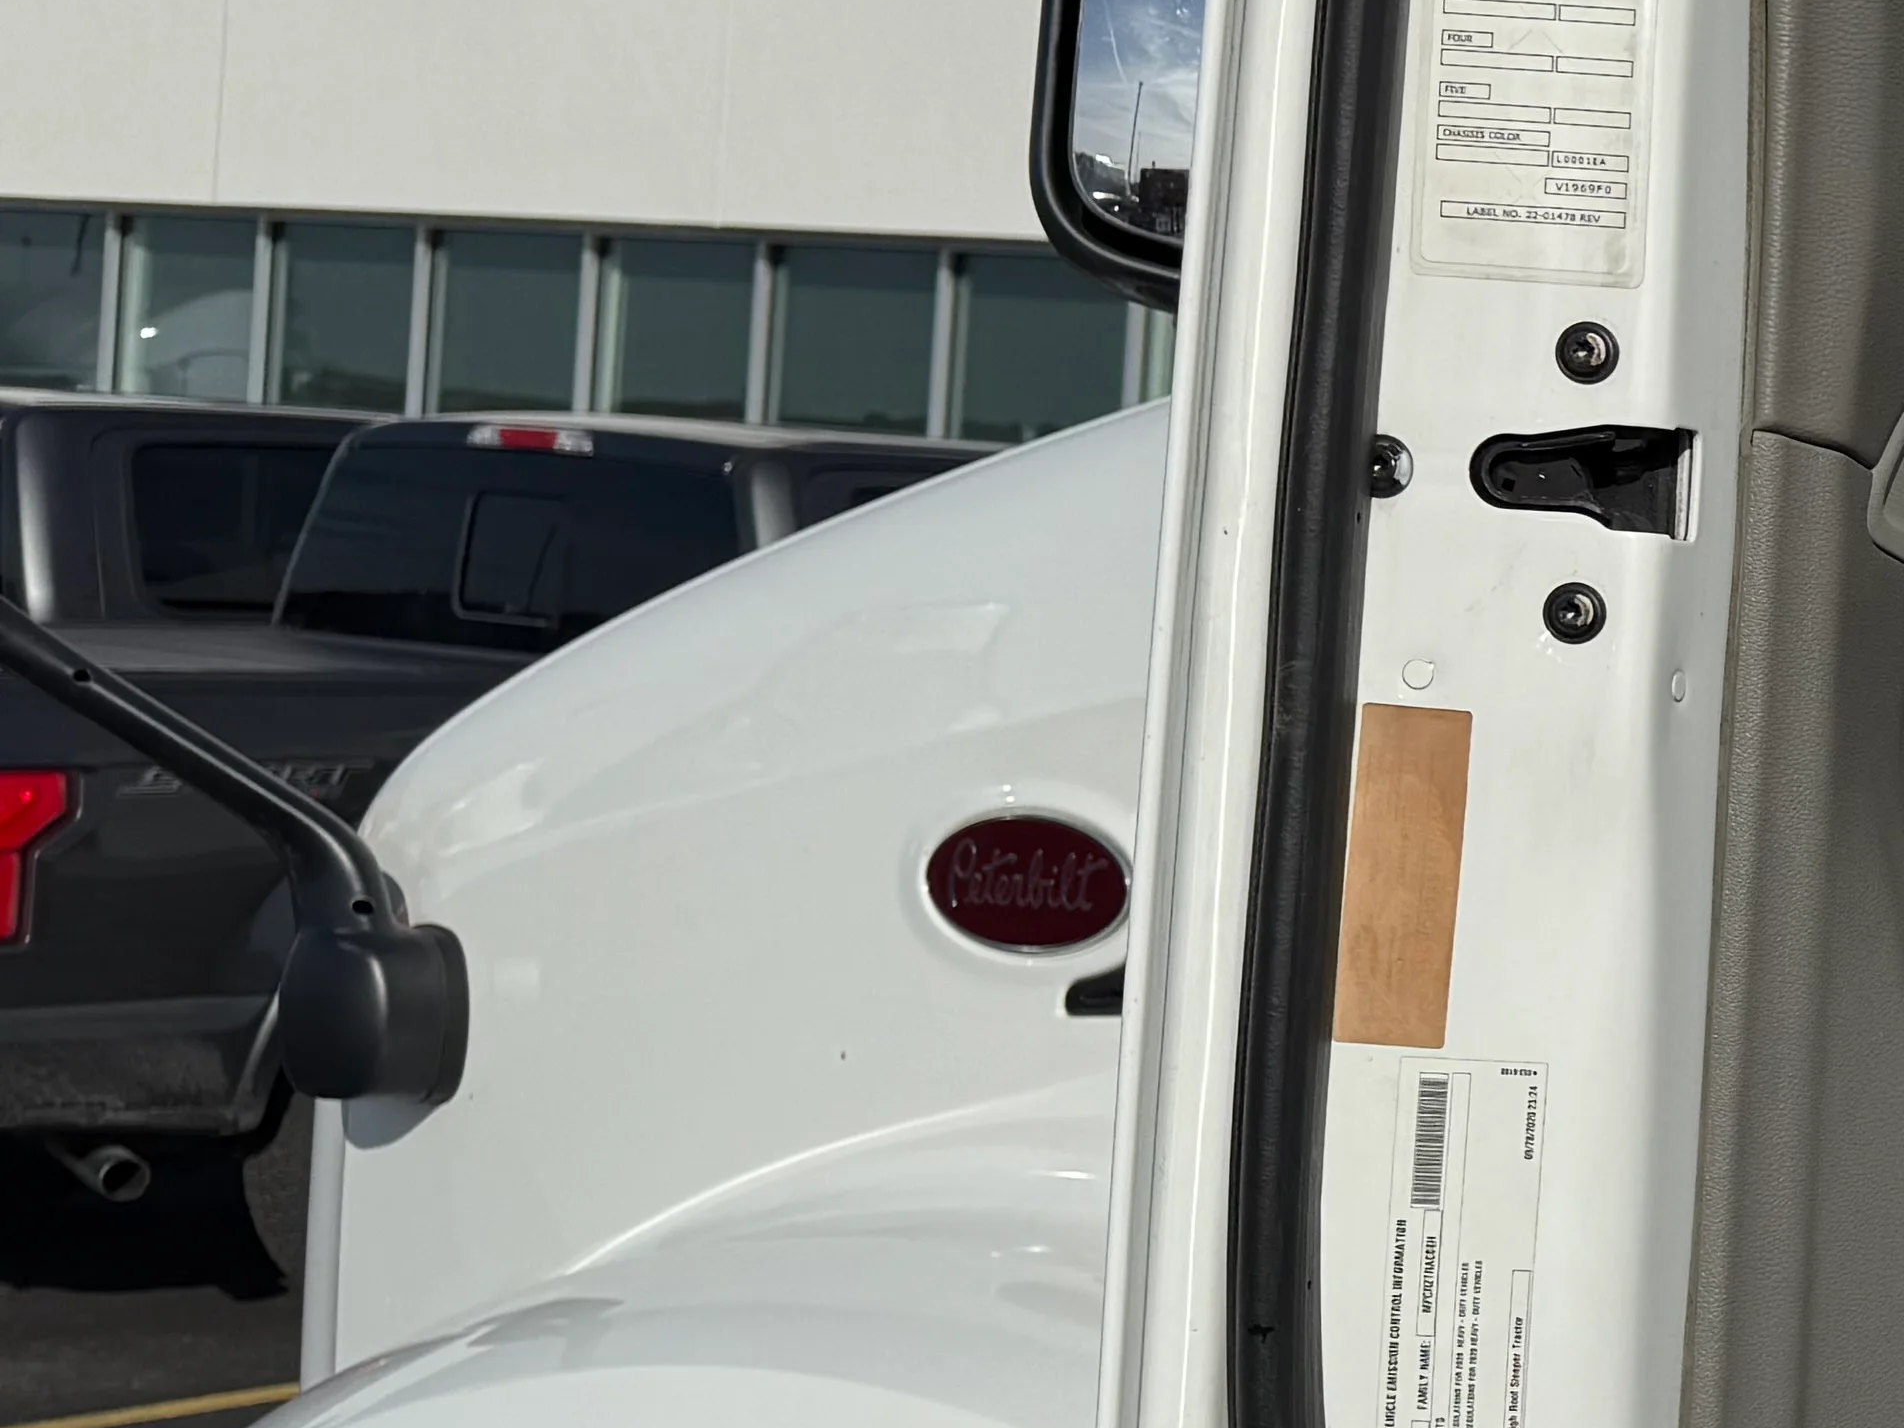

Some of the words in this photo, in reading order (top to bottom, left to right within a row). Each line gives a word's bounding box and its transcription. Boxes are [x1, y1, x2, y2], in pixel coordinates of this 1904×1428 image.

[1466, 206, 1499, 218] LABEL
[1502, 209, 1520, 219] NO.
[1579, 212, 1602, 224] REV
[947, 837, 1109, 913] Peterbilt
[1392, 1219, 1407, 1290] INFORMATION
[1389, 1293, 1403, 1340] CONTROL
